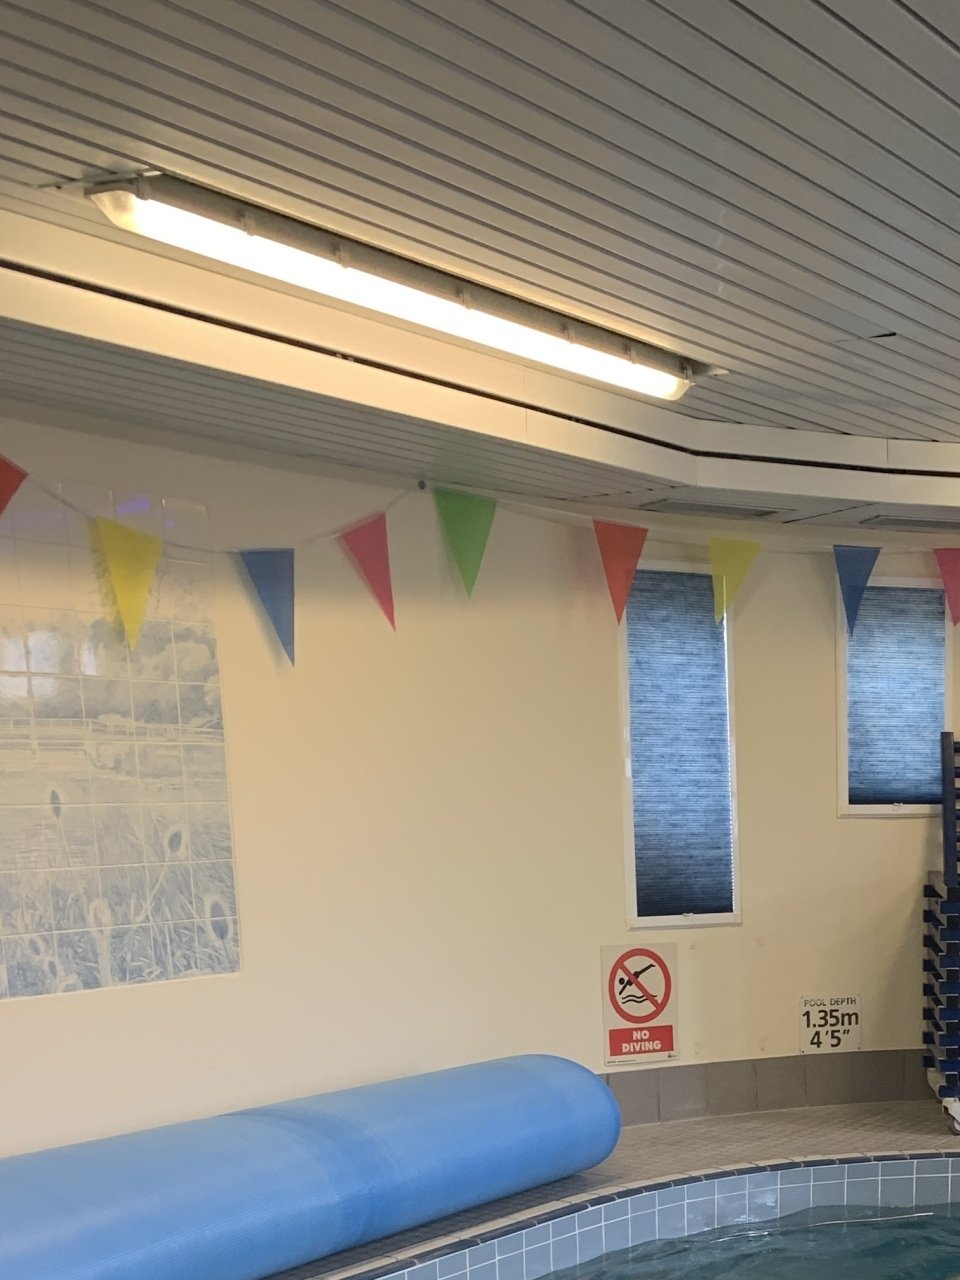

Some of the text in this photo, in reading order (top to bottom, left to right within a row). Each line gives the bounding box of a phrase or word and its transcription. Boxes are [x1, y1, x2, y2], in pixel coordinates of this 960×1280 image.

[803, 997, 857, 1007] POOL DEPTH
[802, 1009, 859, 1028] 1.35m
[632, 1030, 650, 1040] NO
[621, 1040, 662, 1053] DIVING
